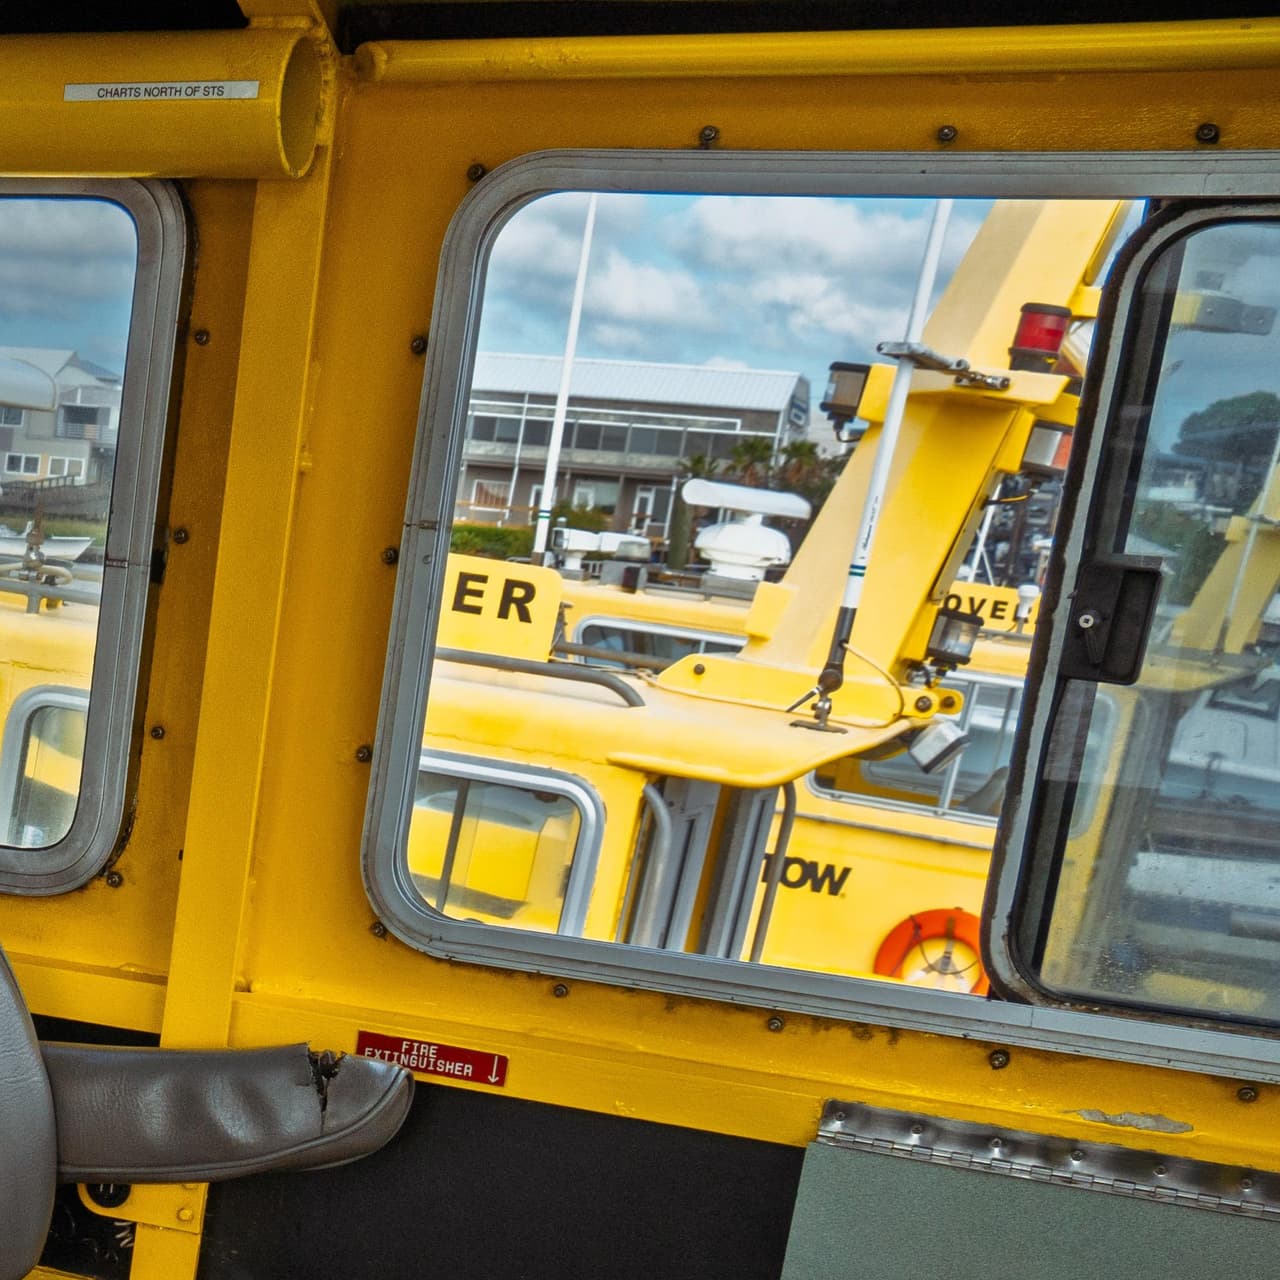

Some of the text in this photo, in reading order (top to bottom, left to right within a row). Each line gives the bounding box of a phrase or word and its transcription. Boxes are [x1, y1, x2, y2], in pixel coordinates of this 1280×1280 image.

[96, 85, 225, 98] CHARTS NORTH OF STS
[401, 1040, 438, 1058] FIRE
[364, 1047, 473, 1077] EXTINGUISHER
